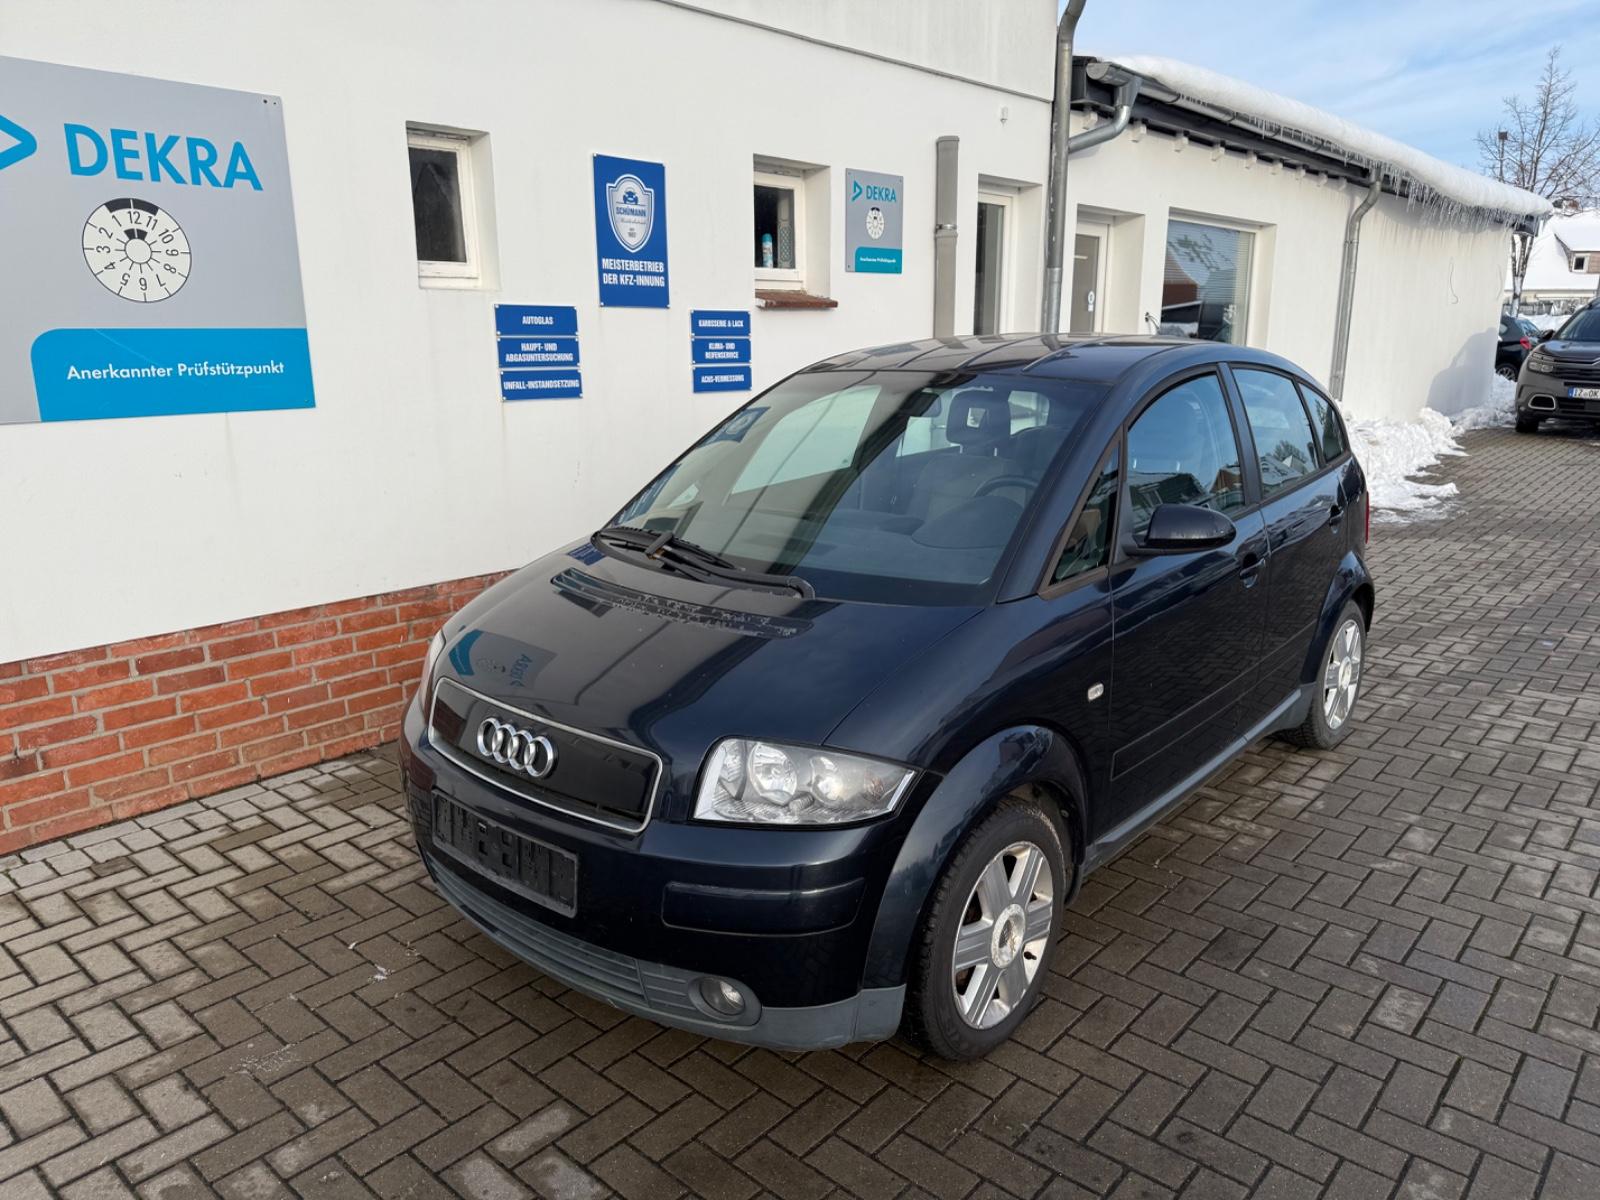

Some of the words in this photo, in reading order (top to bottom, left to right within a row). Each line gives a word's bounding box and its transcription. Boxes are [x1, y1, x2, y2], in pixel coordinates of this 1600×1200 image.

[63, 122, 264, 191] DEKRA
[866, 185, 897, 202] DEKRA
[111, 214, 122, 227] 1
[127, 210, 142, 225] 12
[146, 215, 158, 231] 11
[98, 227, 113, 239] 2
[158, 228, 174, 244] 10
[96, 245, 111, 254] 3
[165, 248, 179, 257] 9
[104, 261, 116, 270] 4
[163, 263, 177, 274] 8
[602, 258, 664, 272] MEISTERBETRIEB
[120, 272, 130, 286] 5
[138, 277, 148, 291] 6
[156, 273, 166, 287] 7
[602, 273, 618, 285] DER
[619, 274, 665, 287] KFZ-INNUNG
[522, 316, 554, 325] AUTOGLAS
[521, 343, 543, 351] HAUPT-
[544, 343, 557, 351] UND
[505, 353, 573, 362] ABGASUNTERSUCHUNG
[67, 363, 173, 381] Anerkannter
[177, 360, 284, 378] Prüfstützpunkt
[503, 380, 579, 390] UNFALL-INSTANDSETZUNG
